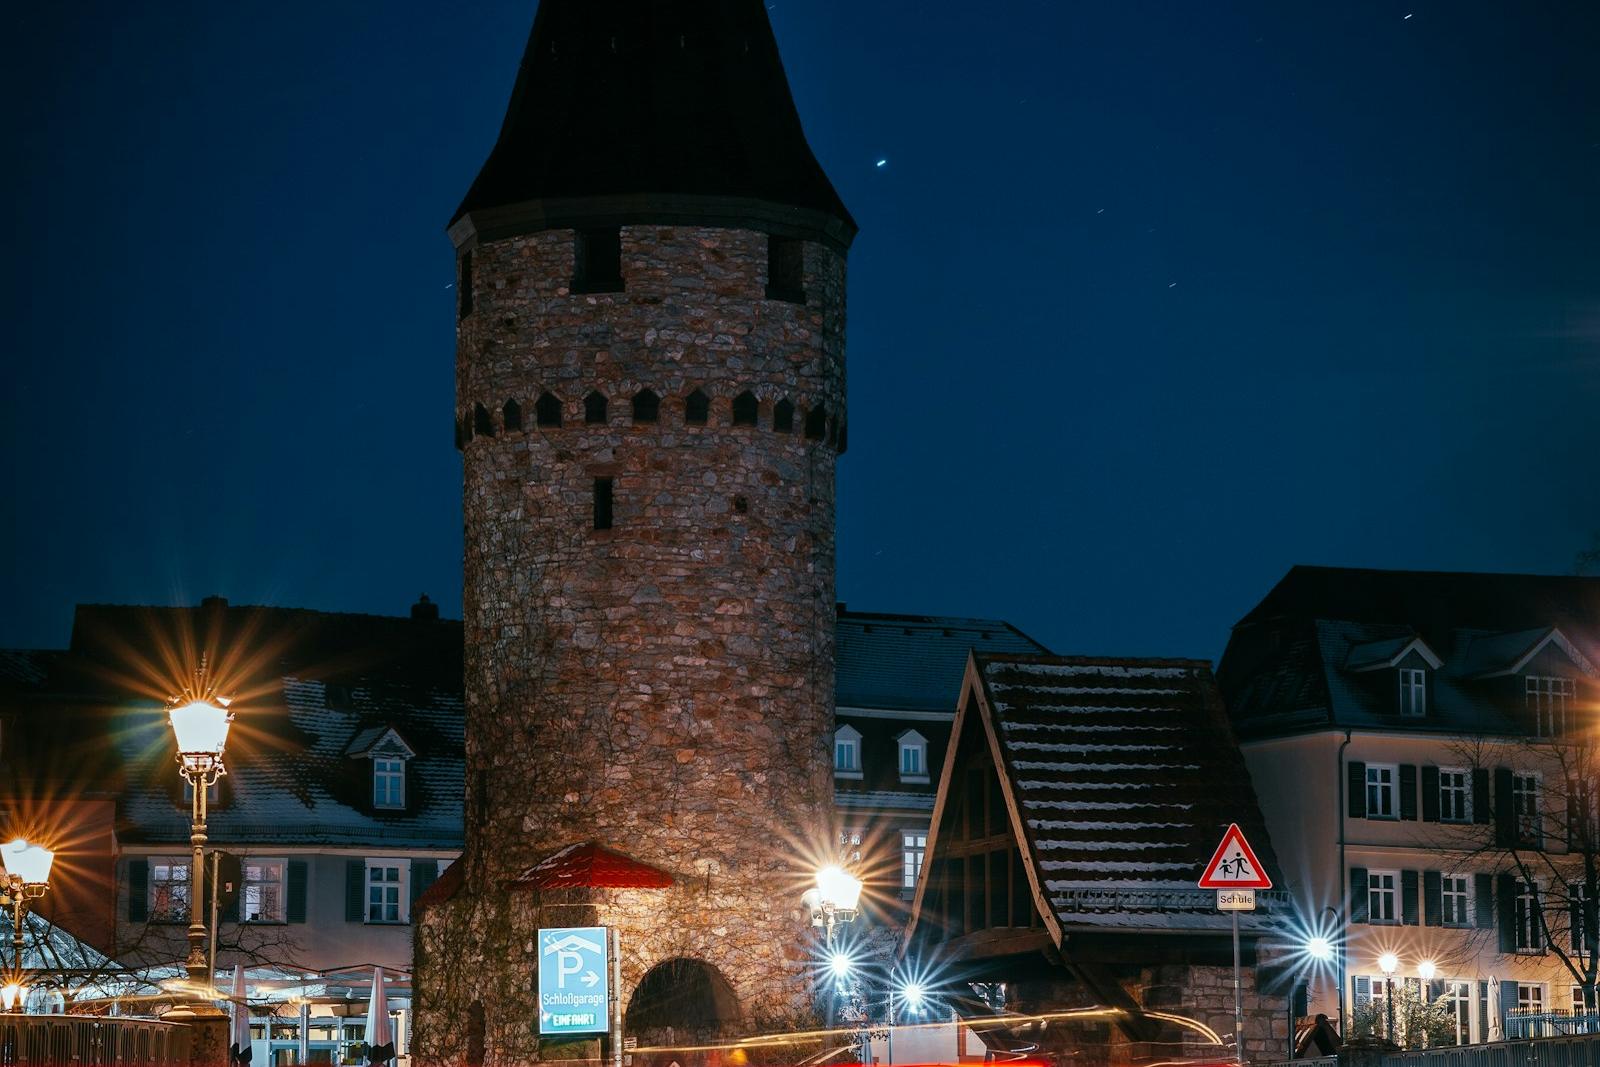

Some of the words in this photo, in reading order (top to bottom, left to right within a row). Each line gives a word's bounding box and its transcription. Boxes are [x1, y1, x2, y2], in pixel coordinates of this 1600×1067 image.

[1220, 895, 1252, 904] Schule
[557, 950, 584, 989] P
[543, 992, 604, 1007] Schloßgarage
[552, 1013, 595, 1027] EINFAHRT
